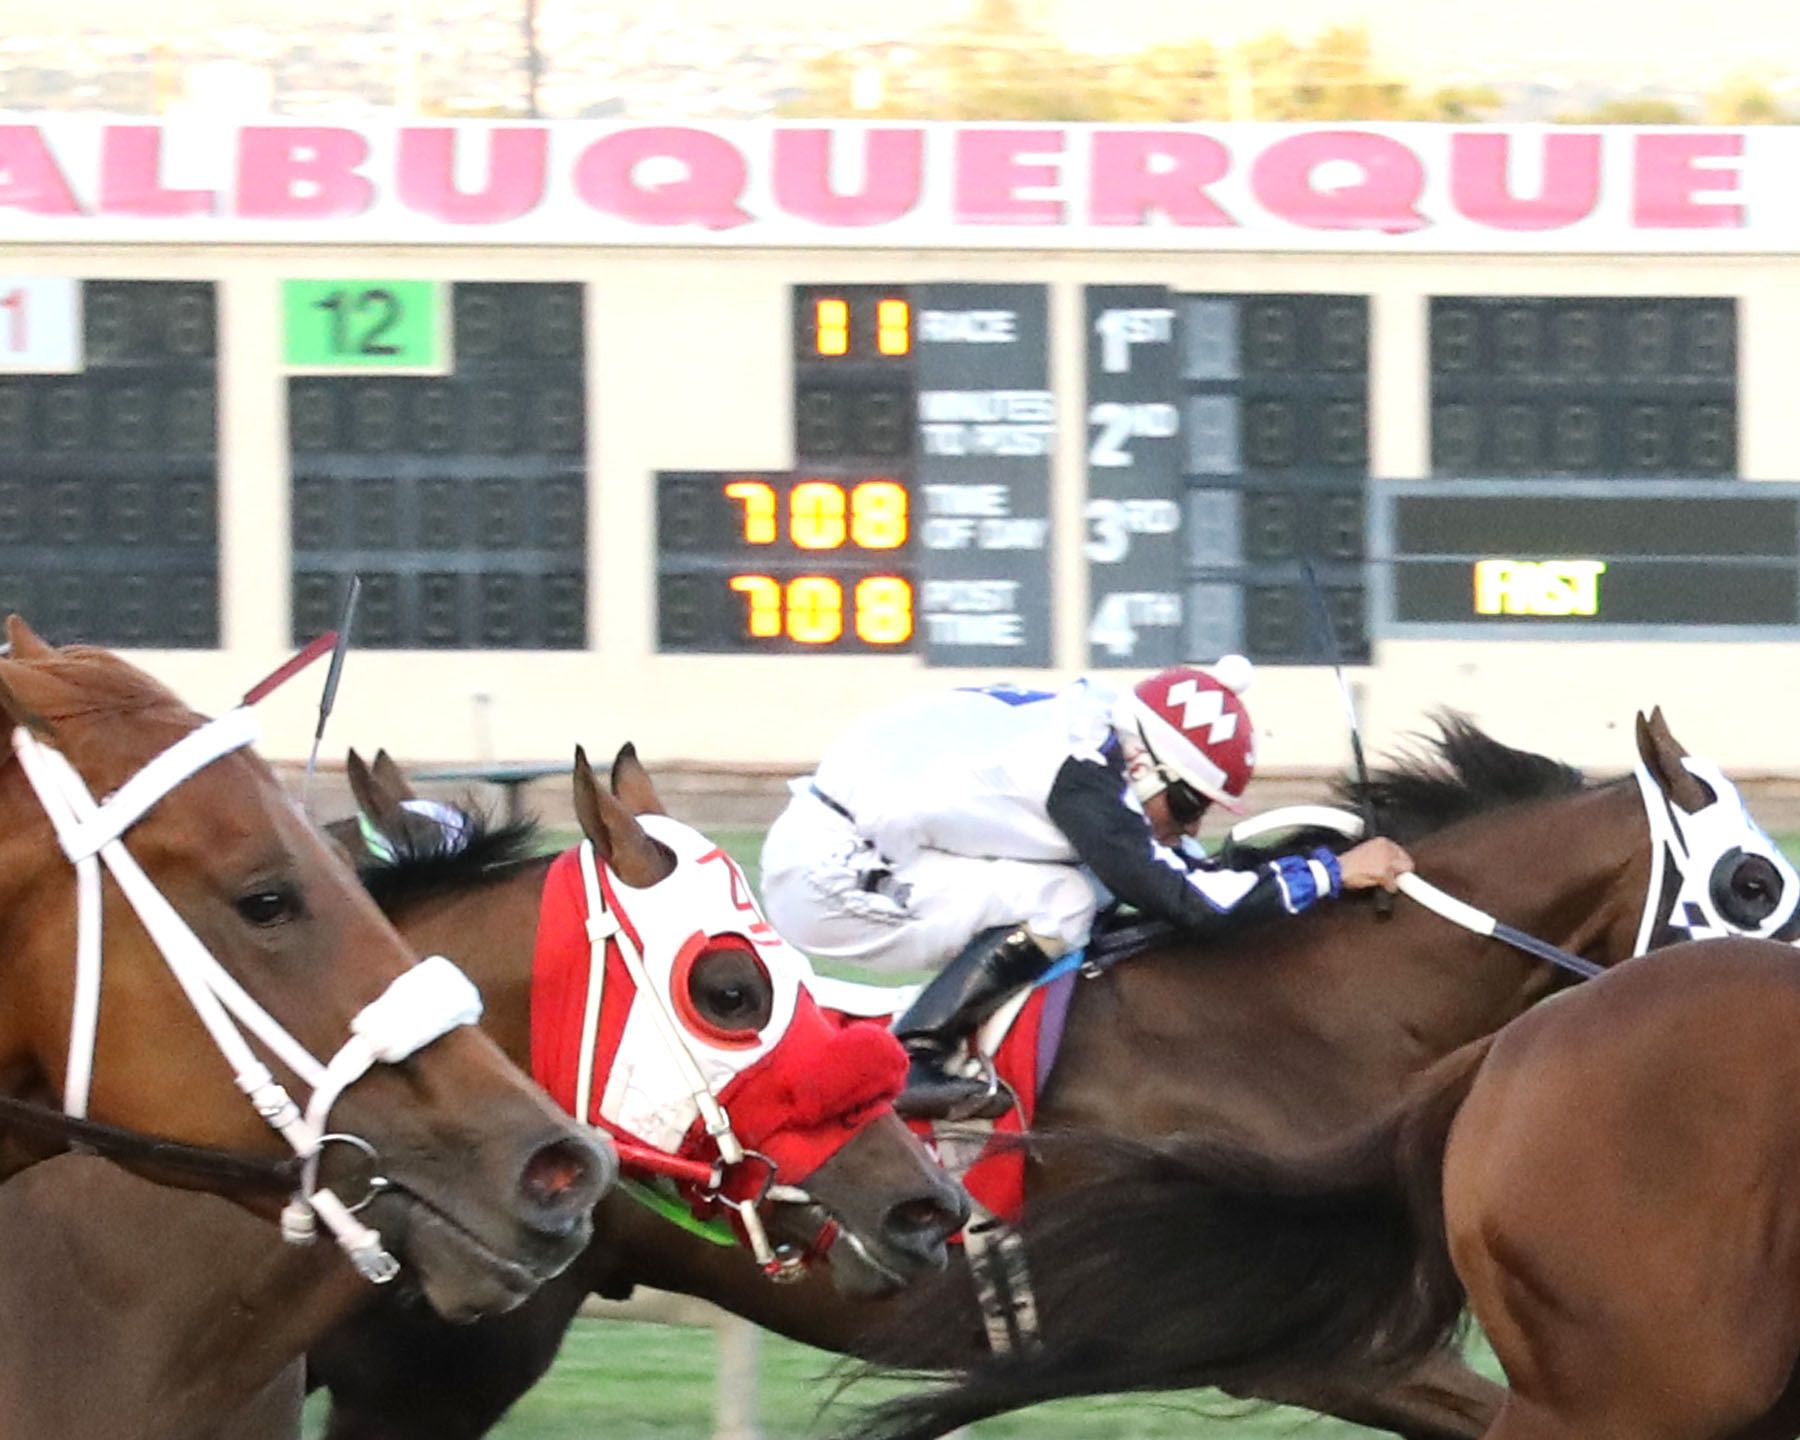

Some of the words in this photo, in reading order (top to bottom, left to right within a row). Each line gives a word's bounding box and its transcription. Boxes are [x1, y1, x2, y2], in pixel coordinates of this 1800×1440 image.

[0, 124, 1747, 236] ALBUQUERQUE
[316, 288, 404, 355] 12
[814, 298, 911, 356] 11
[918, 310, 1018, 343] RACE
[1095, 308, 1177, 373] 1ST
[921, 517, 977, 550] OF
